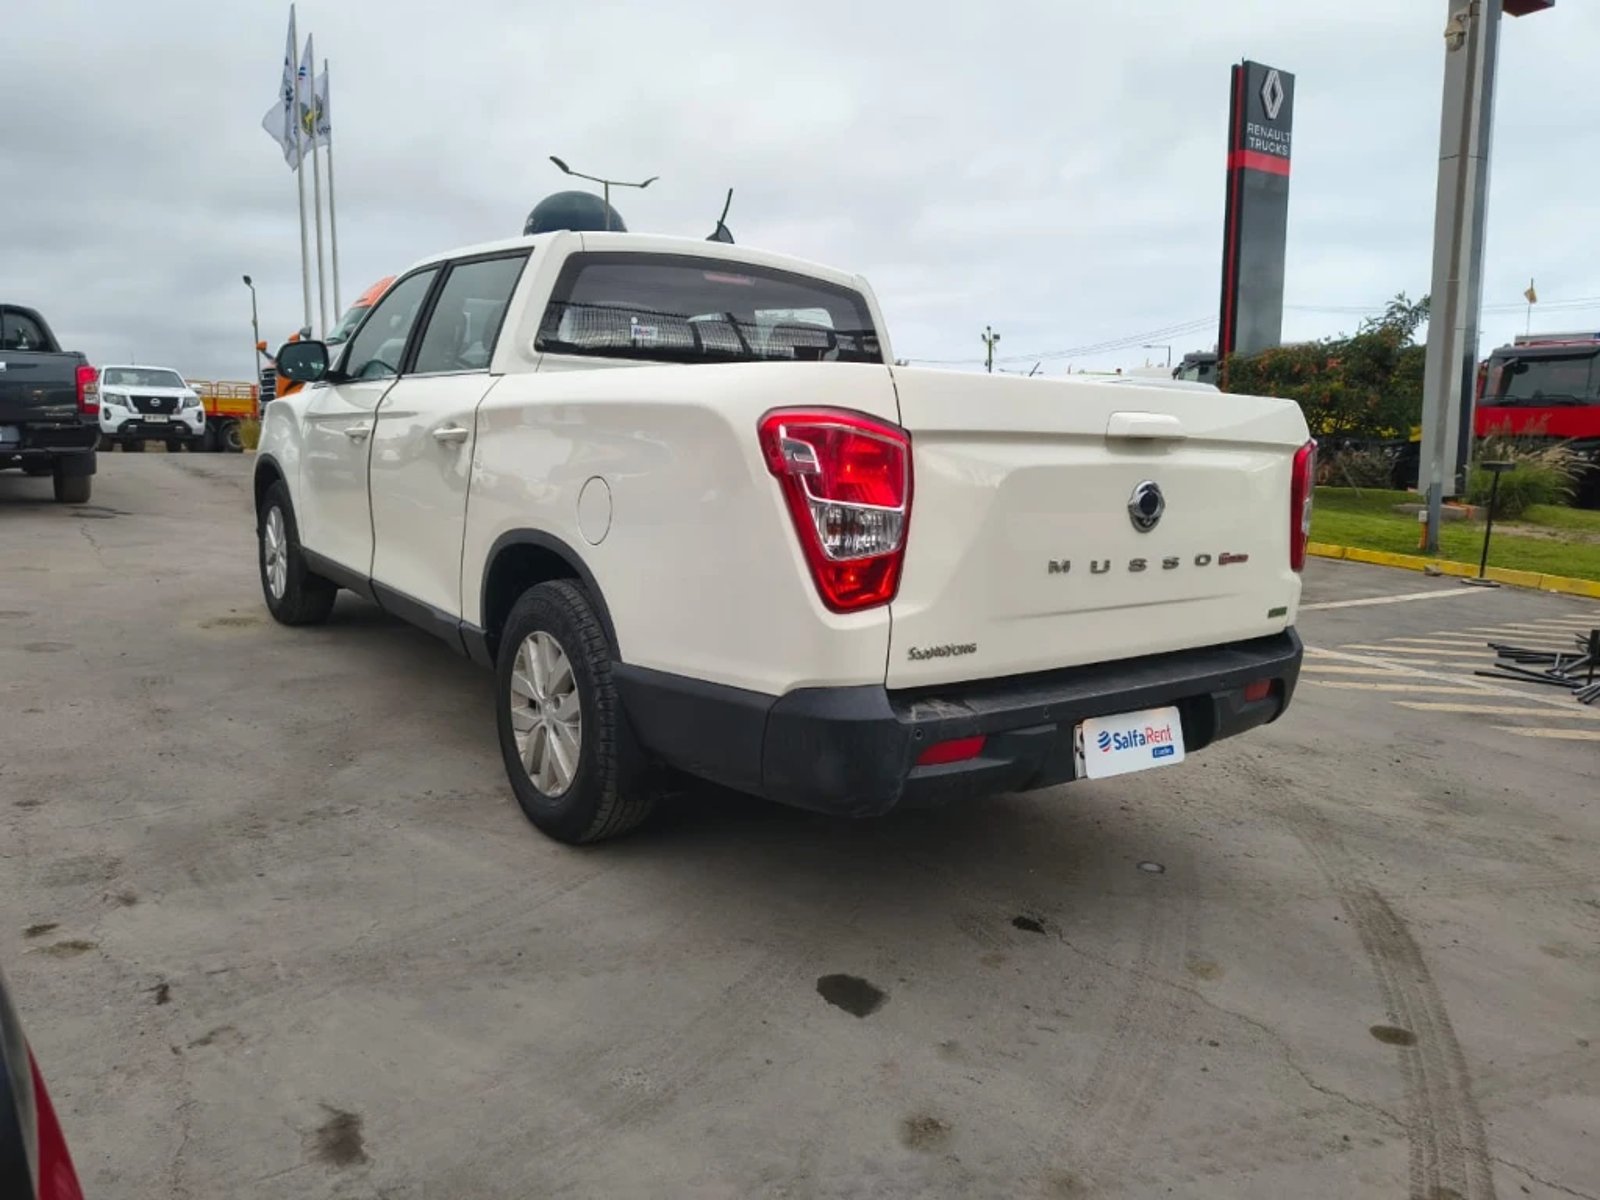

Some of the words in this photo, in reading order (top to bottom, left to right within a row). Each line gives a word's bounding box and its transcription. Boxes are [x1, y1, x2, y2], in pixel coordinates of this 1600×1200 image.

[1247, 122, 1291, 143] RENAULT
[1249, 137, 1288, 156] TRUCKS
[1048, 553, 1212, 575] MUSSO
